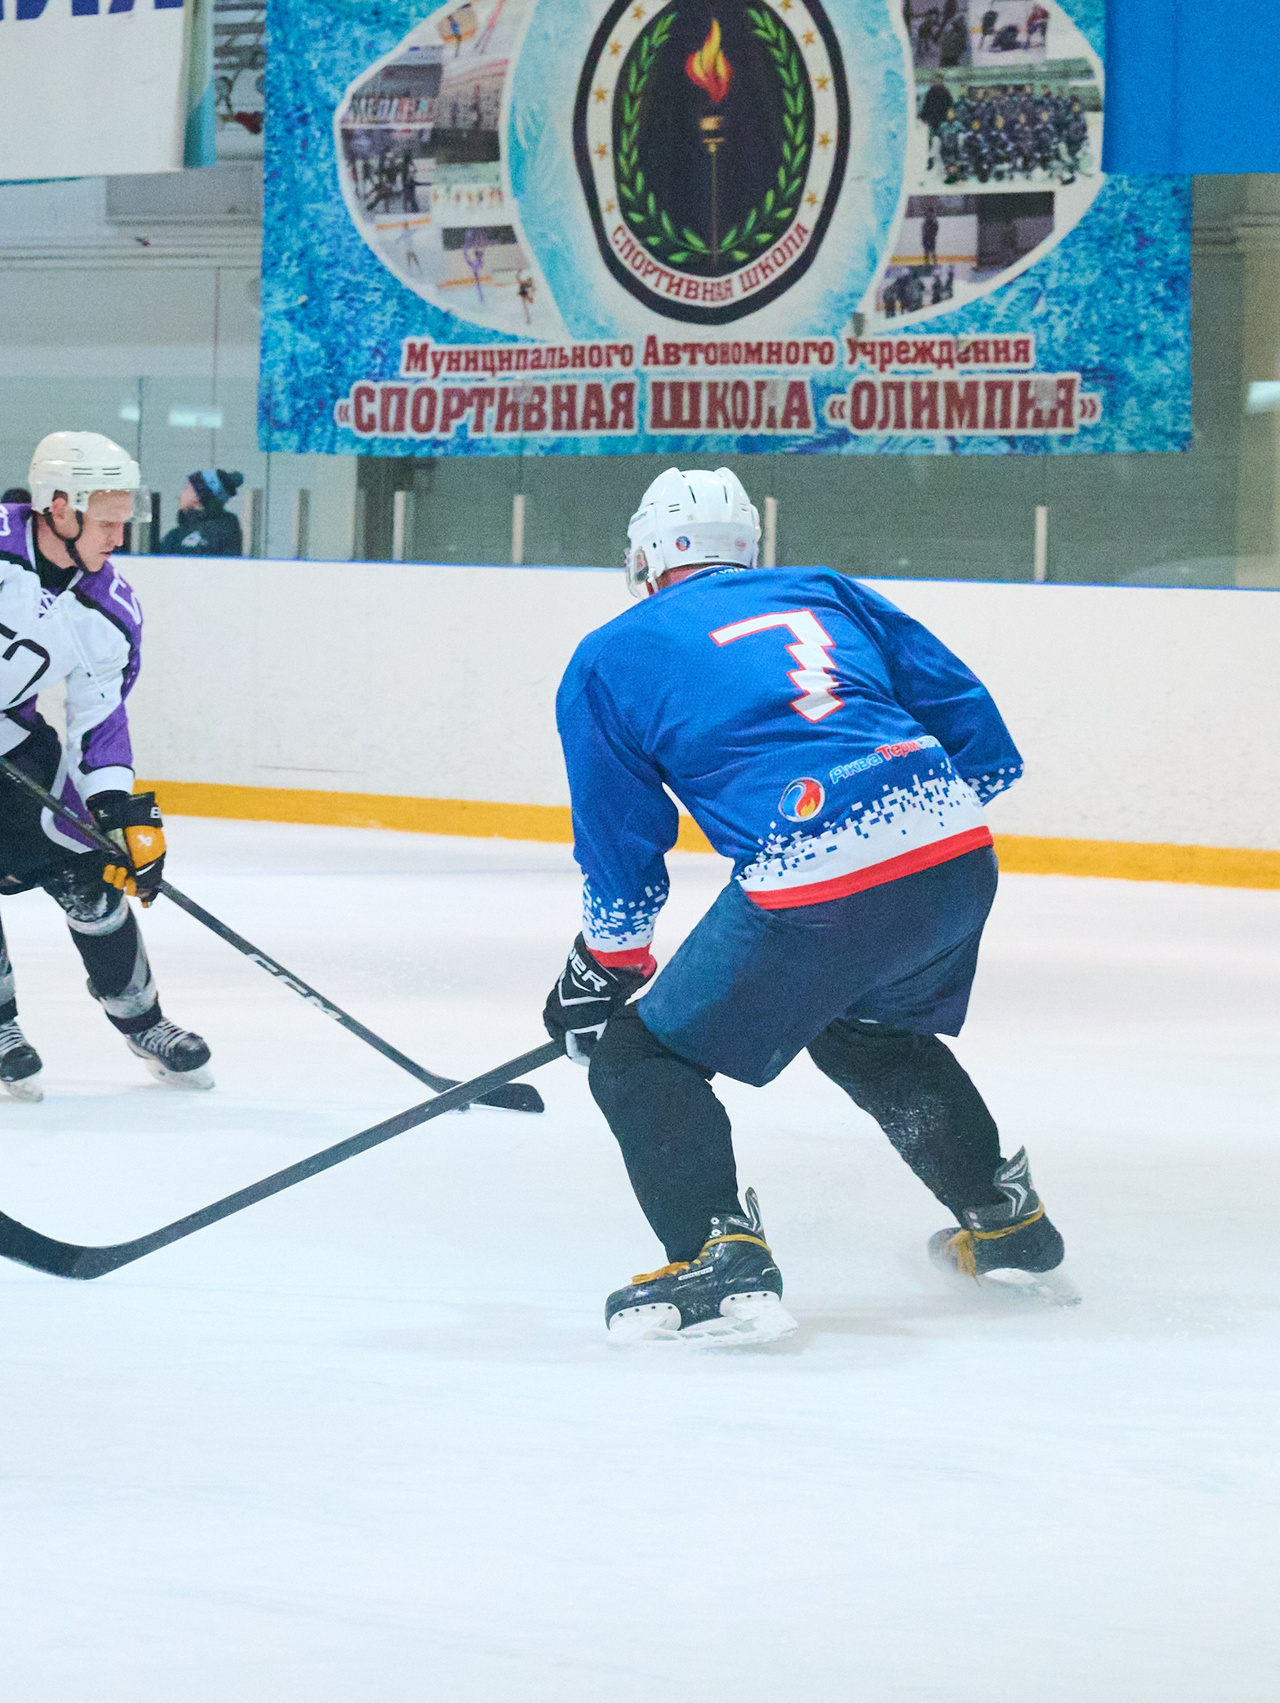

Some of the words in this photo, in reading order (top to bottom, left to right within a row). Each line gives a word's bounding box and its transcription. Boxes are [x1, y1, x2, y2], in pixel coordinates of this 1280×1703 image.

[612, 224, 734, 300] СПОРТИВНАЯ
[740, 222, 808, 292] ШКОЛА
[404, 342, 634, 378] Муниципального
[642, 334, 835, 367] Автономного
[707, 607, 846, 724] 7
